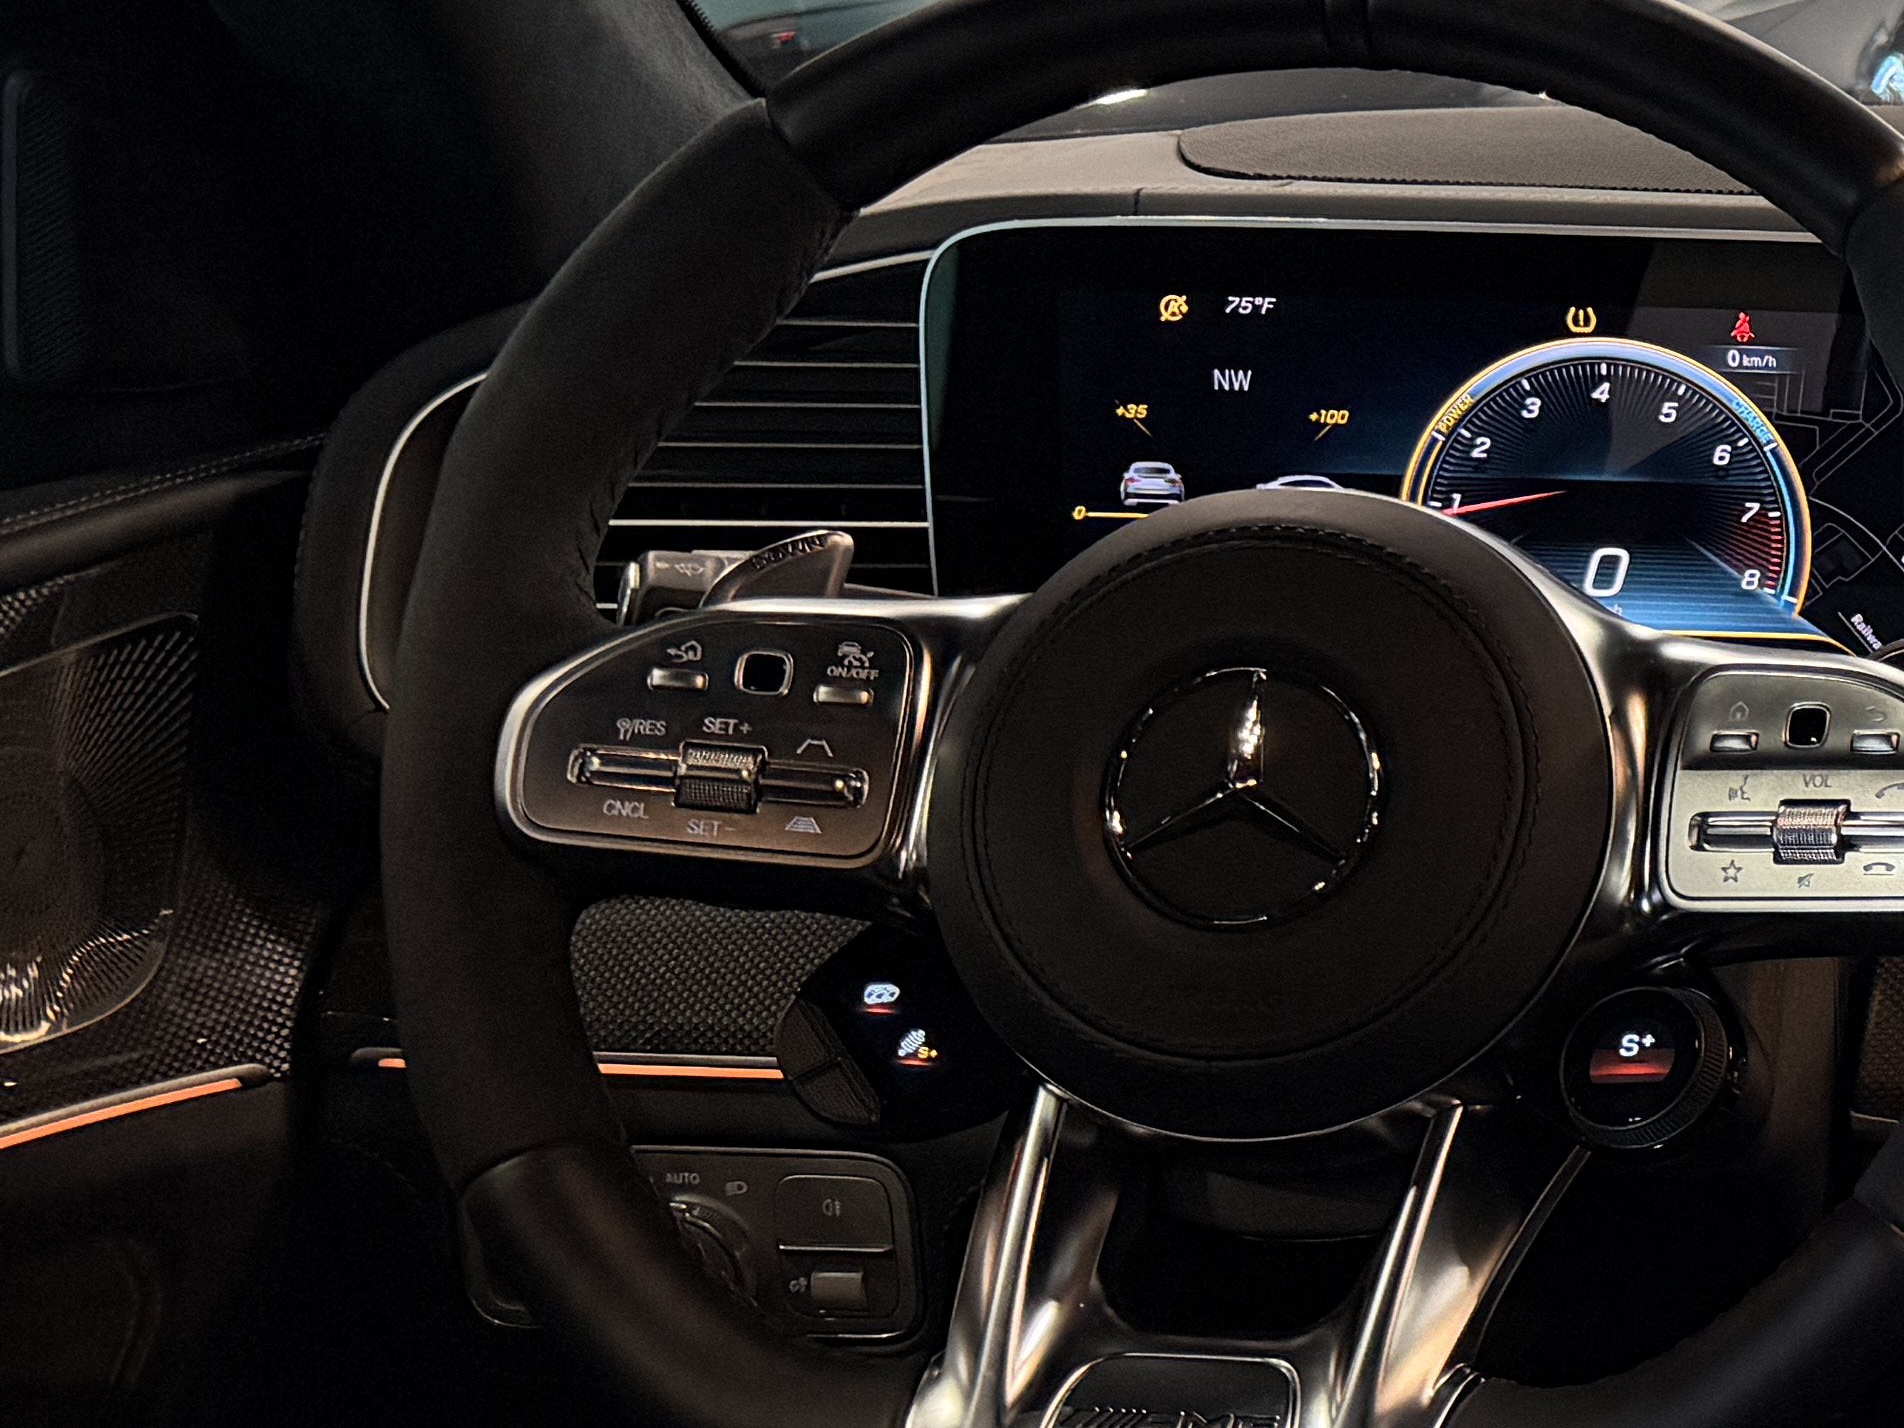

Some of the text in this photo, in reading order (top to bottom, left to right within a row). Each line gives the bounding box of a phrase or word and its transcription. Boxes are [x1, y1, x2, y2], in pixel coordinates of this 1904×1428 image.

[1224, 295, 1277, 316] 75°F
[1727, 349, 1778, 369] 0 km/h
[1212, 369, 1252, 392] NW
[1591, 382, 1611, 404] 4
[1521, 397, 1543, 419] 3
[1658, 401, 1679, 423] 5
[1471, 436, 1491, 459] 2
[1712, 444, 1732, 466] 6
[1742, 502, 1760, 523] 7
[1584, 546, 1630, 597] 0
[1741, 569, 1760, 591] 8
[827, 666, 879, 680] ON/OFF
[1803, 773, 1832, 789] VOL
[603, 800, 649, 820] CNCL
[1619, 1034, 1655, 1057] S+
[665, 1172, 700, 1185] AUTO
